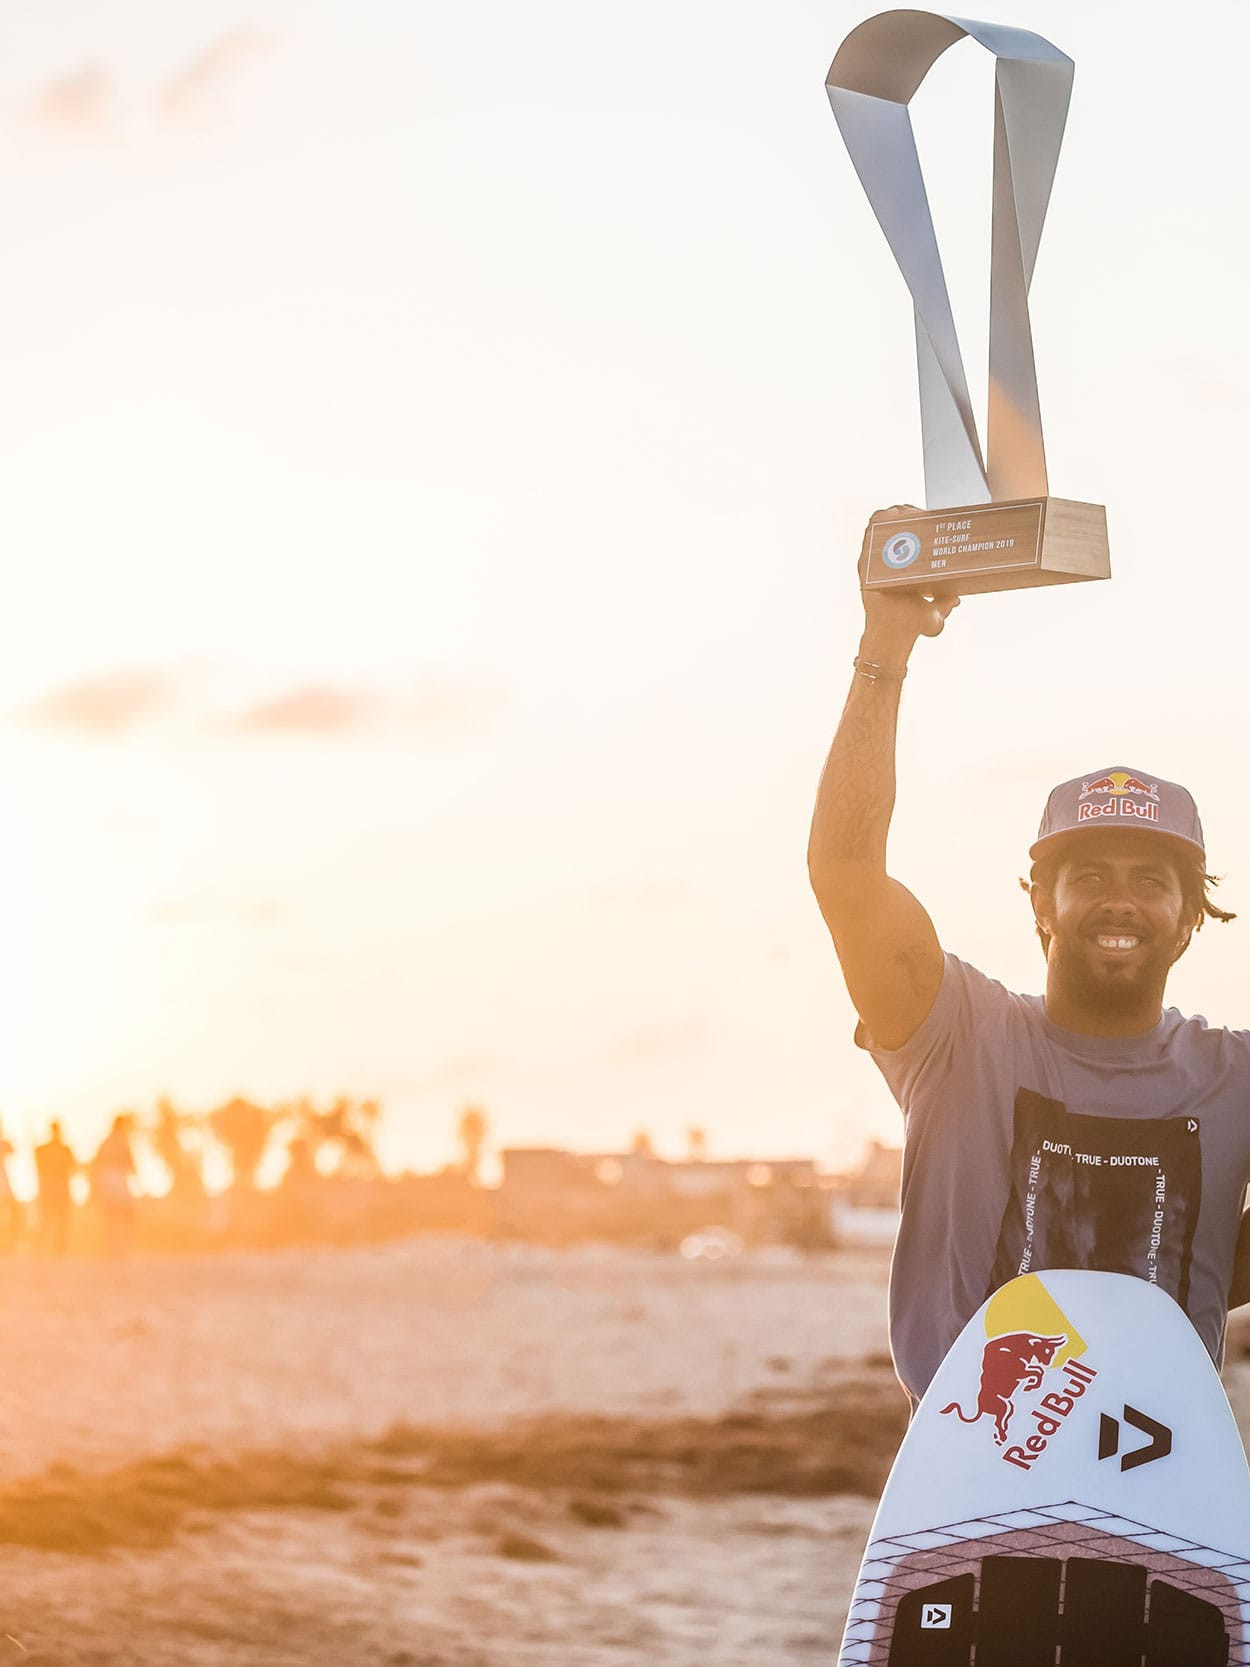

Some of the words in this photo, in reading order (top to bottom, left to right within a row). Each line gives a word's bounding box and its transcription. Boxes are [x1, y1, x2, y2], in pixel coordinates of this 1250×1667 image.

[947, 520, 972, 531] PLACE
[932, 546, 956, 556] WORLD
[958, 541, 994, 553] CHAMPION
[996, 538, 1014, 549] 2019
[934, 534, 970, 545] KITE-SURF
[931, 559, 946, 568] MEN
[1079, 797, 1116, 822] Red
[1121, 798, 1158, 822] Bull
[1042, 1140, 1072, 1156] DUOT
[1075, 1153, 1102, 1166] TRUE
[1110, 1156, 1160, 1166] DUOTONE
[1028, 1154, 1042, 1184] TRUE
[1156, 1174, 1166, 1203] TRUE
[1148, 1210, 1164, 1260] DUOTONE
[1002, 1410, 1062, 1470] Red
[1040, 1358, 1098, 1417] Bull
